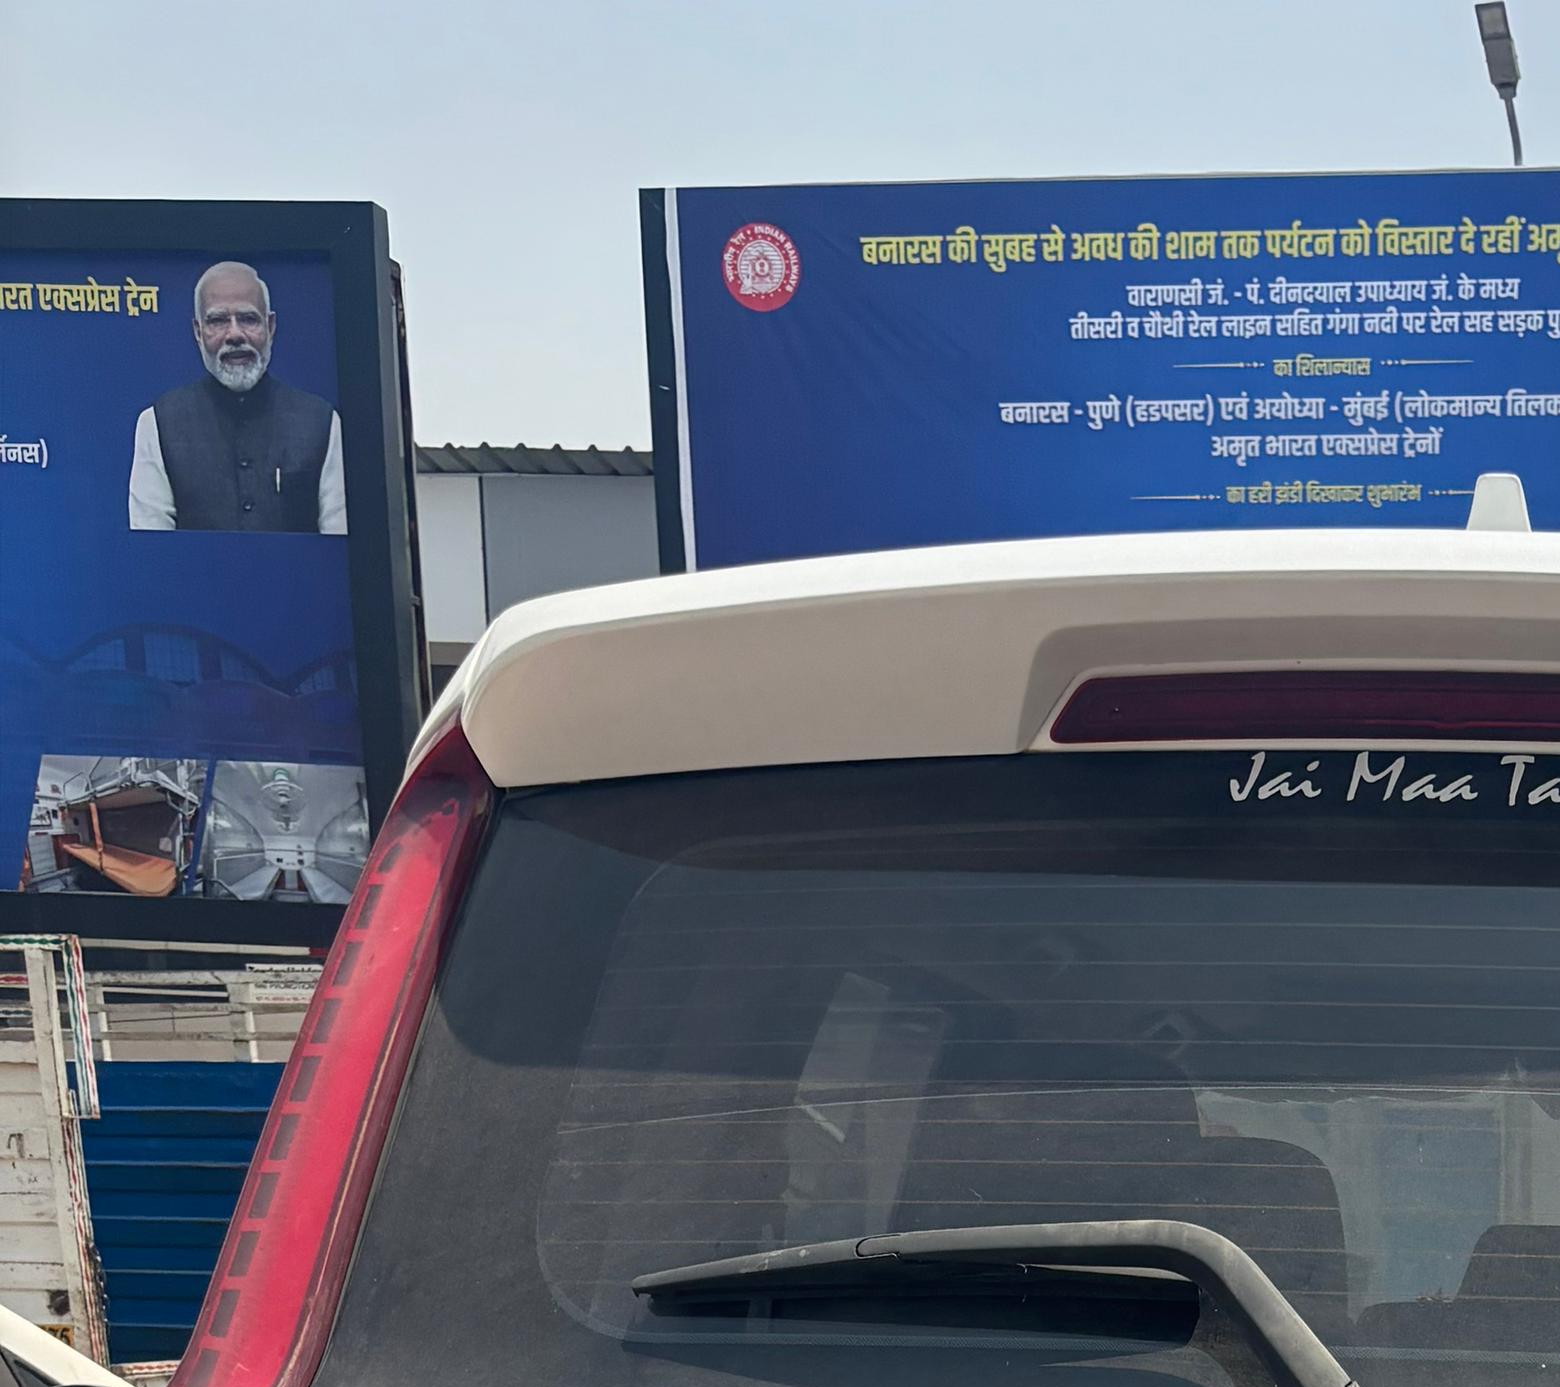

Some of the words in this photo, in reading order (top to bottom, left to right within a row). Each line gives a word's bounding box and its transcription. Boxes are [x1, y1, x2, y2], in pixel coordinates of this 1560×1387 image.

[754, 225, 786, 243] INDIAN
[784, 241, 800, 293] RAILWAYS
[860, 236, 943, 264] बनारस
[946, 226, 979, 263] की
[981, 234, 1037, 272] सुबह
[1040, 225, 1065, 261] से
[1071, 233, 1125, 261] अवध
[1128, 223, 1160, 260] की
[1166, 231, 1218, 259] शाम
[1220, 231, 1261, 258] तक
[1264, 220, 1337, 258] पर्यटन
[1339, 219, 1372, 256] को
[1375, 219, 1456, 255] विस्तार
[1458, 217, 1477, 253] दे
[1480, 216, 1526, 253] रहीं
[36, 276, 121, 312] एक्सप्रेस
[124, 277, 159, 316] ट्रेन
[1126, 278, 1203, 306] वाराणसी
[1206, 279, 1228, 305] जं.
[1246, 278, 1264, 304] पं.
[1268, 277, 1352, 304] दीनदयाल
[1355, 281, 1427, 302] उपाध्याय
[1430, 274, 1452, 300] जं.
[1457, 273, 1476, 300] के
[1479, 279, 1520, 299] मध्य
[1070, 311, 1123, 338] तीसरी
[1126, 318, 1140, 338] व
[1142, 310, 1185, 337] चौथी
[1187, 310, 1218, 337] रेल
[1220, 315, 1273, 338] लाइन
[1275, 308, 1324, 335] सहित
[1326, 308, 1361, 334] गंगा
[1362, 306, 1398, 333] नदी
[1401, 312, 1427, 333] पर
[1429, 306, 1461, 333] रेल
[1463, 311, 1494, 332] सह
[1497, 310, 1545, 337] सड़क
[1273, 359, 1293, 376] का
[1295, 353, 1371, 376] शिलान्यास
[999, 402, 1070, 423] बनारस
[1086, 394, 1121, 429] पुणे
[1126, 394, 1214, 427] (हडपसर)
[1218, 392, 1249, 420] एवं
[1254, 392, 1325, 419] अयोध्या
[1342, 390, 1389, 426] मुंबई
[1395, 390, 1503, 422] (लोकमान्य
[1212, 436, 1261, 466] अमृत
[1266, 435, 1318, 456] भारत
[1320, 427, 1400, 455] एक्सप्रेस
[1402, 427, 1443, 457] ट्रेनों
[1229, 751, 1322, 802] Jai
[1346, 751, 1479, 803] Maa
